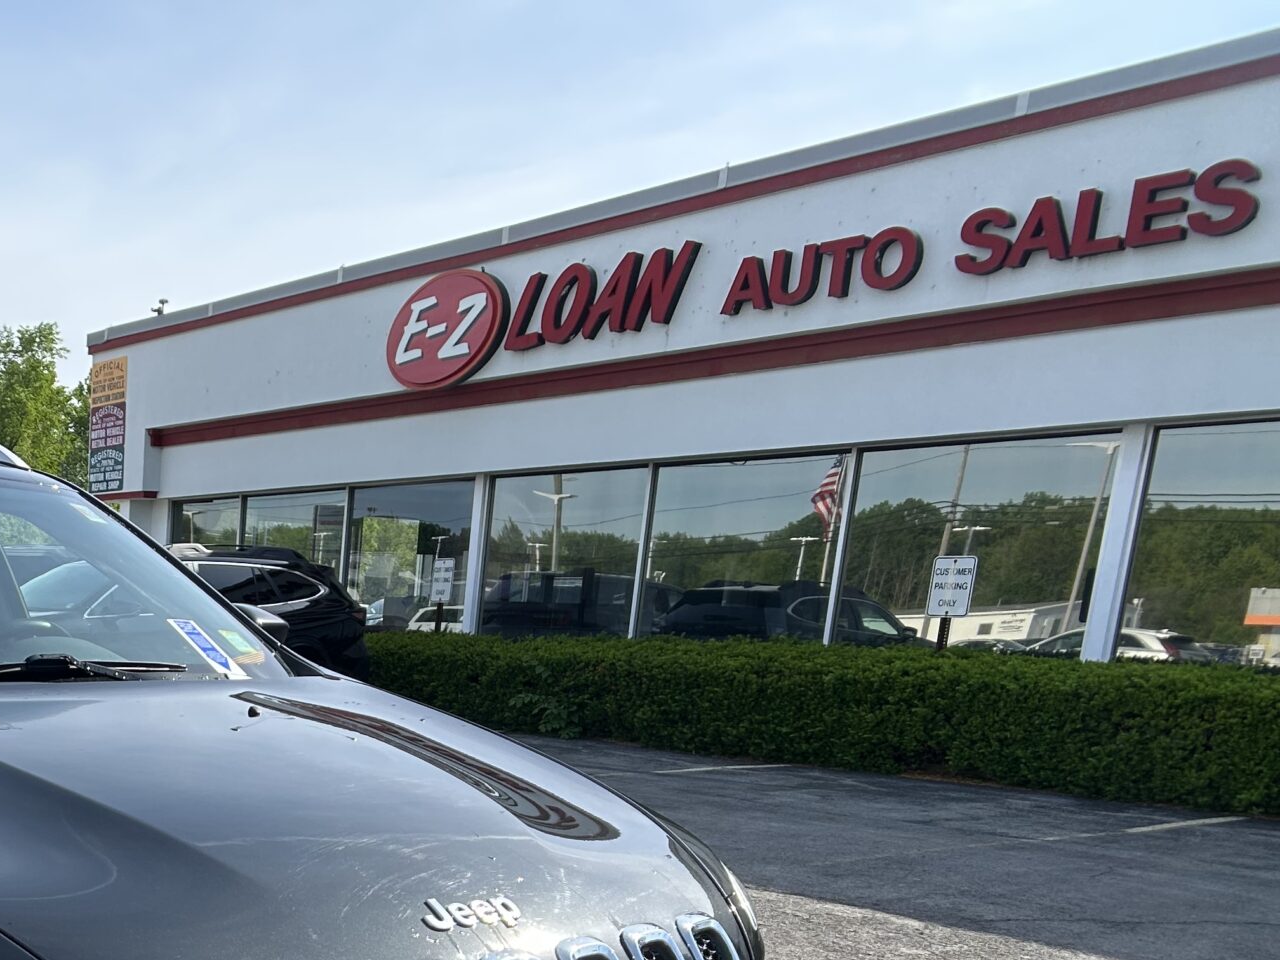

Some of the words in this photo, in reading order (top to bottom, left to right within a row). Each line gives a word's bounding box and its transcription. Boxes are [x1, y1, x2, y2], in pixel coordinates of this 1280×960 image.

[394, 290, 489, 366] E-Z
[505, 239, 702, 352] LOAN
[721, 226, 922, 316] AUTO
[955, 158, 1261, 276] SALES
[94, 361, 124, 378] OFFICIAL
[93, 383, 106, 394] MOTOR
[107, 379, 124, 391] VEHICLE
[92, 405, 124, 424] REGISTERED
[91, 428, 106, 439] MOTOR
[106, 426, 124, 437] VEHICLE
[106, 435, 123, 446] DEALER
[90, 449, 123, 466] REGISTERED
[90, 472, 104, 482] MOTOR
[105, 470, 123, 480] VEHICLE
[91, 481, 107, 491] REPAIR
[107, 480, 120, 490] SHOP
[934, 581, 968, 591] PARKING
[937, 598, 958, 607] ONLY
[422, 894, 521, 932] Jeep
